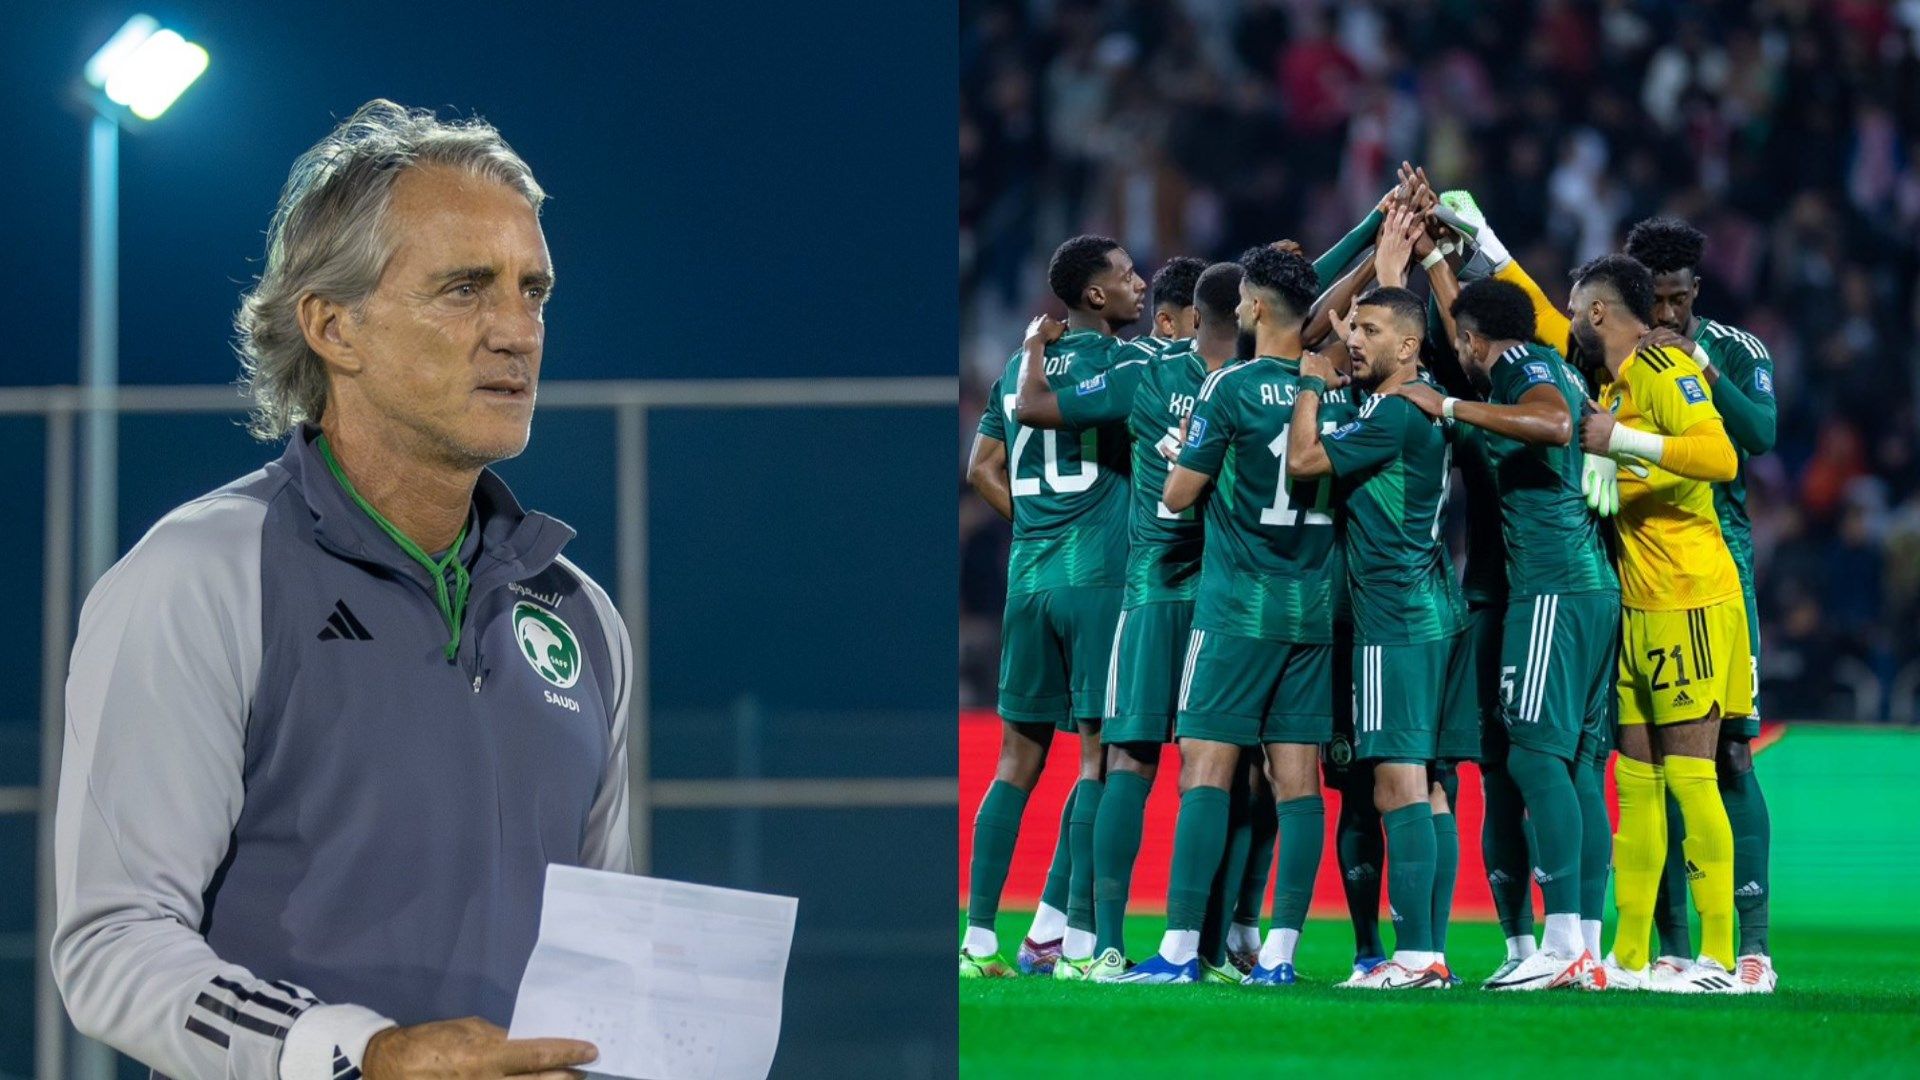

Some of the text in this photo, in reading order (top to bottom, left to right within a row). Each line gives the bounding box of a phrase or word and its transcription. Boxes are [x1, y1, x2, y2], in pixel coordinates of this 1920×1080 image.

[1003, 393, 1098, 497] 20
[1647, 644, 1691, 692] 21
[544, 690, 580, 713] SAUDI
